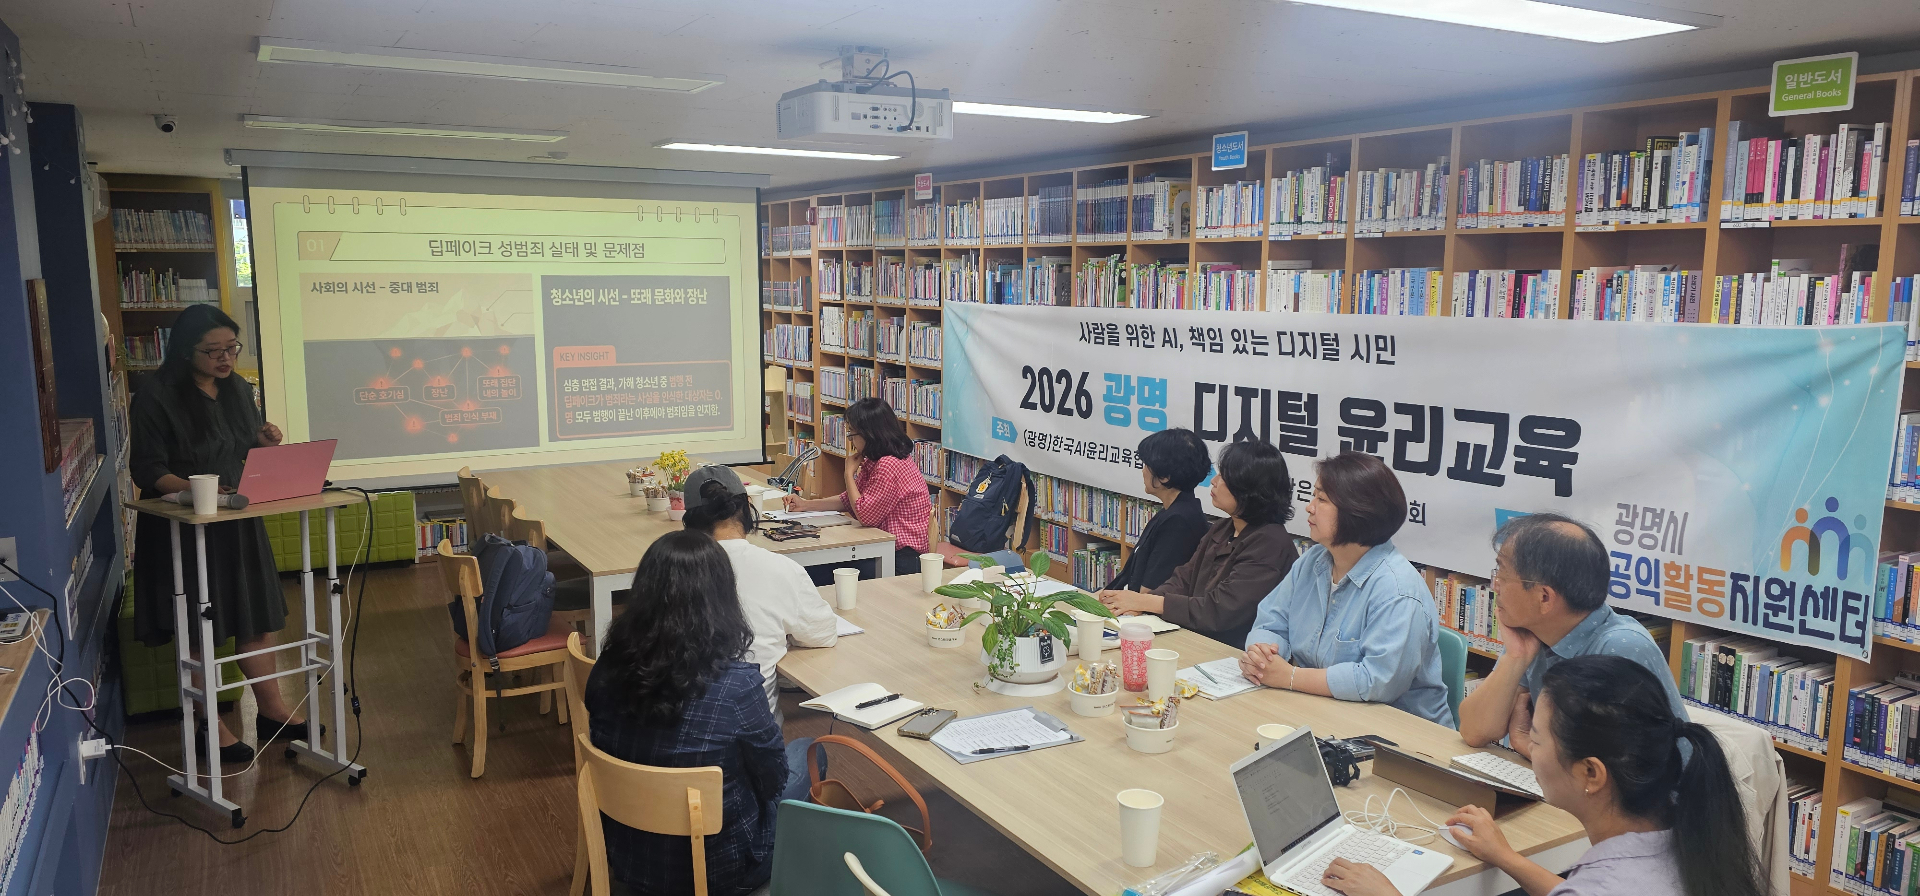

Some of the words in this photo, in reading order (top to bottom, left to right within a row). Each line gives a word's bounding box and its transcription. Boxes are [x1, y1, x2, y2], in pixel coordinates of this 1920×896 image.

[1785, 69, 1842, 89] 일반도서
[1782, 91, 1814, 101] General
[1816, 88, 1841, 98] Books
[1216, 141, 1244, 154] 청소년도서
[306, 239, 325, 252] 01
[428, 239, 494, 257] 딥페이크
[497, 240, 545, 258] 성범죄
[548, 241, 579, 258] 실태
[583, 242, 598, 258] 및
[602, 242, 645, 259] 문제점
[310, 281, 349, 295] 사회의
[351, 281, 376, 294] 시선
[388, 281, 413, 294] 중대
[415, 281, 440, 294] 범죄
[550, 288, 595, 306] 청소년의
[598, 288, 620, 305] 시선
[630, 289, 652, 305] 또래
[653, 289, 685, 305] 문화와
[686, 289, 708, 304] 장난
[1689, 292, 1696, 304] 사전
[1078, 321, 1121, 348] 사람을
[1125, 324, 1156, 349] 위한
[1161, 326, 1184, 353] AI,
[1189, 325, 1224, 354] 책임
[1230, 328, 1270, 357] 있는
[1276, 330, 1341, 362] 디지털
[1350, 333, 1397, 366] 시민
[559, 352, 575, 362] KEY
[577, 351, 610, 362] INSIGHT
[482, 378, 499, 388] 또래
[500, 377, 517, 388] 집단
[563, 378, 580, 392] 심층
[581, 377, 597, 391] 면접
[598, 377, 618, 391] 결과,
[618, 377, 635, 390] 가해
[635, 376, 659, 389] 청소년
[659, 375, 667, 388] 중
[669, 375, 684, 388] 범행
[685, 375, 693, 387] 전
[359, 390, 377, 401] 단순
[378, 389, 405, 400] 호기심
[431, 388, 449, 398] 장난
[483, 388, 499, 398] 내의
[500, 387, 517, 398] 놀이
[564, 393, 604, 408] 딥페이크가
[605, 391, 636, 406] 범죄라는
[637, 391, 661, 405] 사실을
[661, 390, 684, 404] 인식한
[684, 389, 713, 403] 대상자는
[444, 412, 461, 423] 범죄
[463, 411, 479, 422] 인식
[481, 410, 497, 421] 부재
[564, 411, 573, 424] 명
[575, 410, 592, 423] 모두
[592, 408, 617, 423] 범행이
[617, 407, 634, 422] 끝난
[634, 406, 666, 420] 이후에야
[666, 404, 696, 419] 범죄임을
[696, 403, 721, 417] 인지함.
[996, 420, 1012, 439] 주최
[1019, 365, 1093, 420] 2026
[1103, 372, 1168, 433] 광명
[1194, 381, 1319, 457] 디지털
[1337, 396, 1582, 498] 윤리교육
[1614, 502, 1689, 556] 광명시
[1609, 550, 1870, 649] 공익활동지원센터
